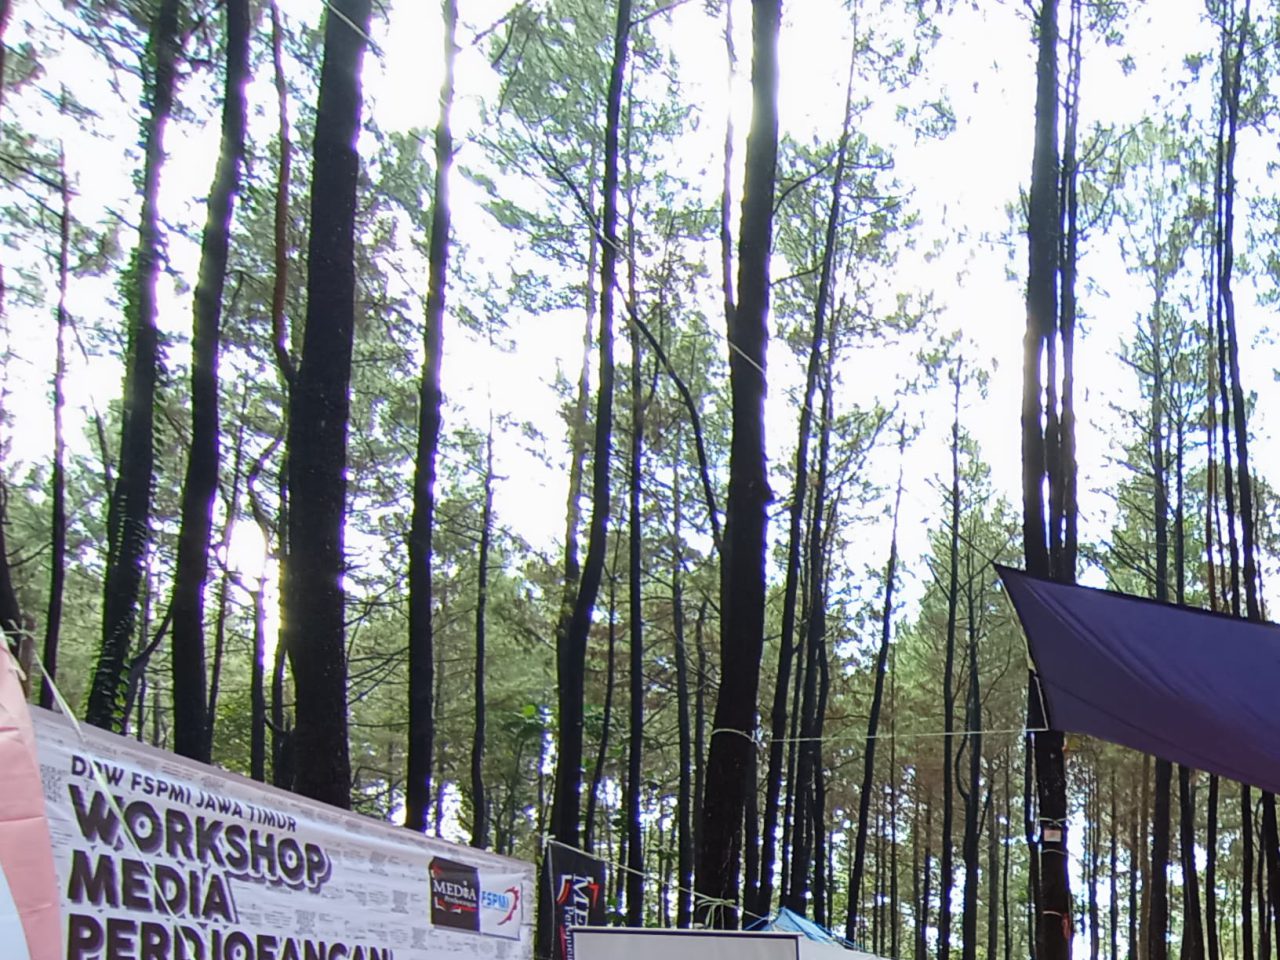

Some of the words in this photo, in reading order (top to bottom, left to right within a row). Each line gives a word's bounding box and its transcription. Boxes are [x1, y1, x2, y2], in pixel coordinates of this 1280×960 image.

[68, 784, 328, 887] WORKSHOP
[131, 772, 191, 804] FSPMI
[196, 791, 244, 819] JAWA
[247, 805, 298, 833] TIMUR
[67, 849, 235, 923] MEDIA
